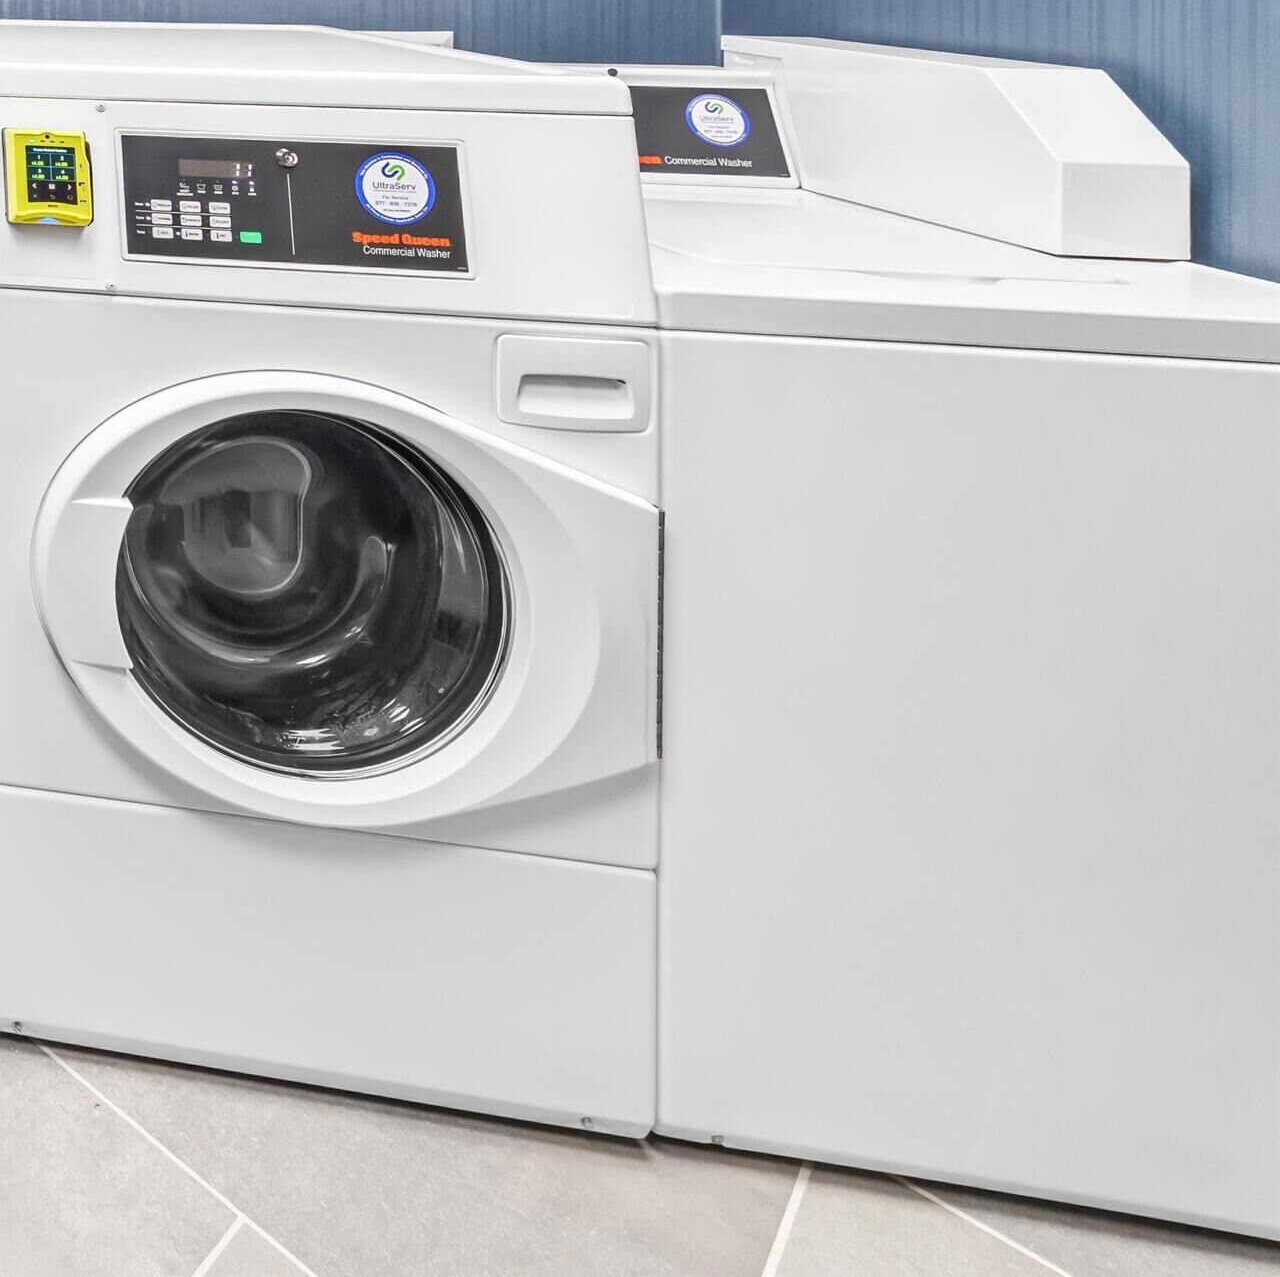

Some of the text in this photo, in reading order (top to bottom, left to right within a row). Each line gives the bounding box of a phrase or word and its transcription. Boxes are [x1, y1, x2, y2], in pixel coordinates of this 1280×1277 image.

[664, 155, 717, 166] Commercial
[718, 157, 752, 168] Washer
[372, 181, 416, 191] UltraServ
[352, 231, 451, 247] Speed Queen
[363, 245, 451, 259] Commercial Washer
